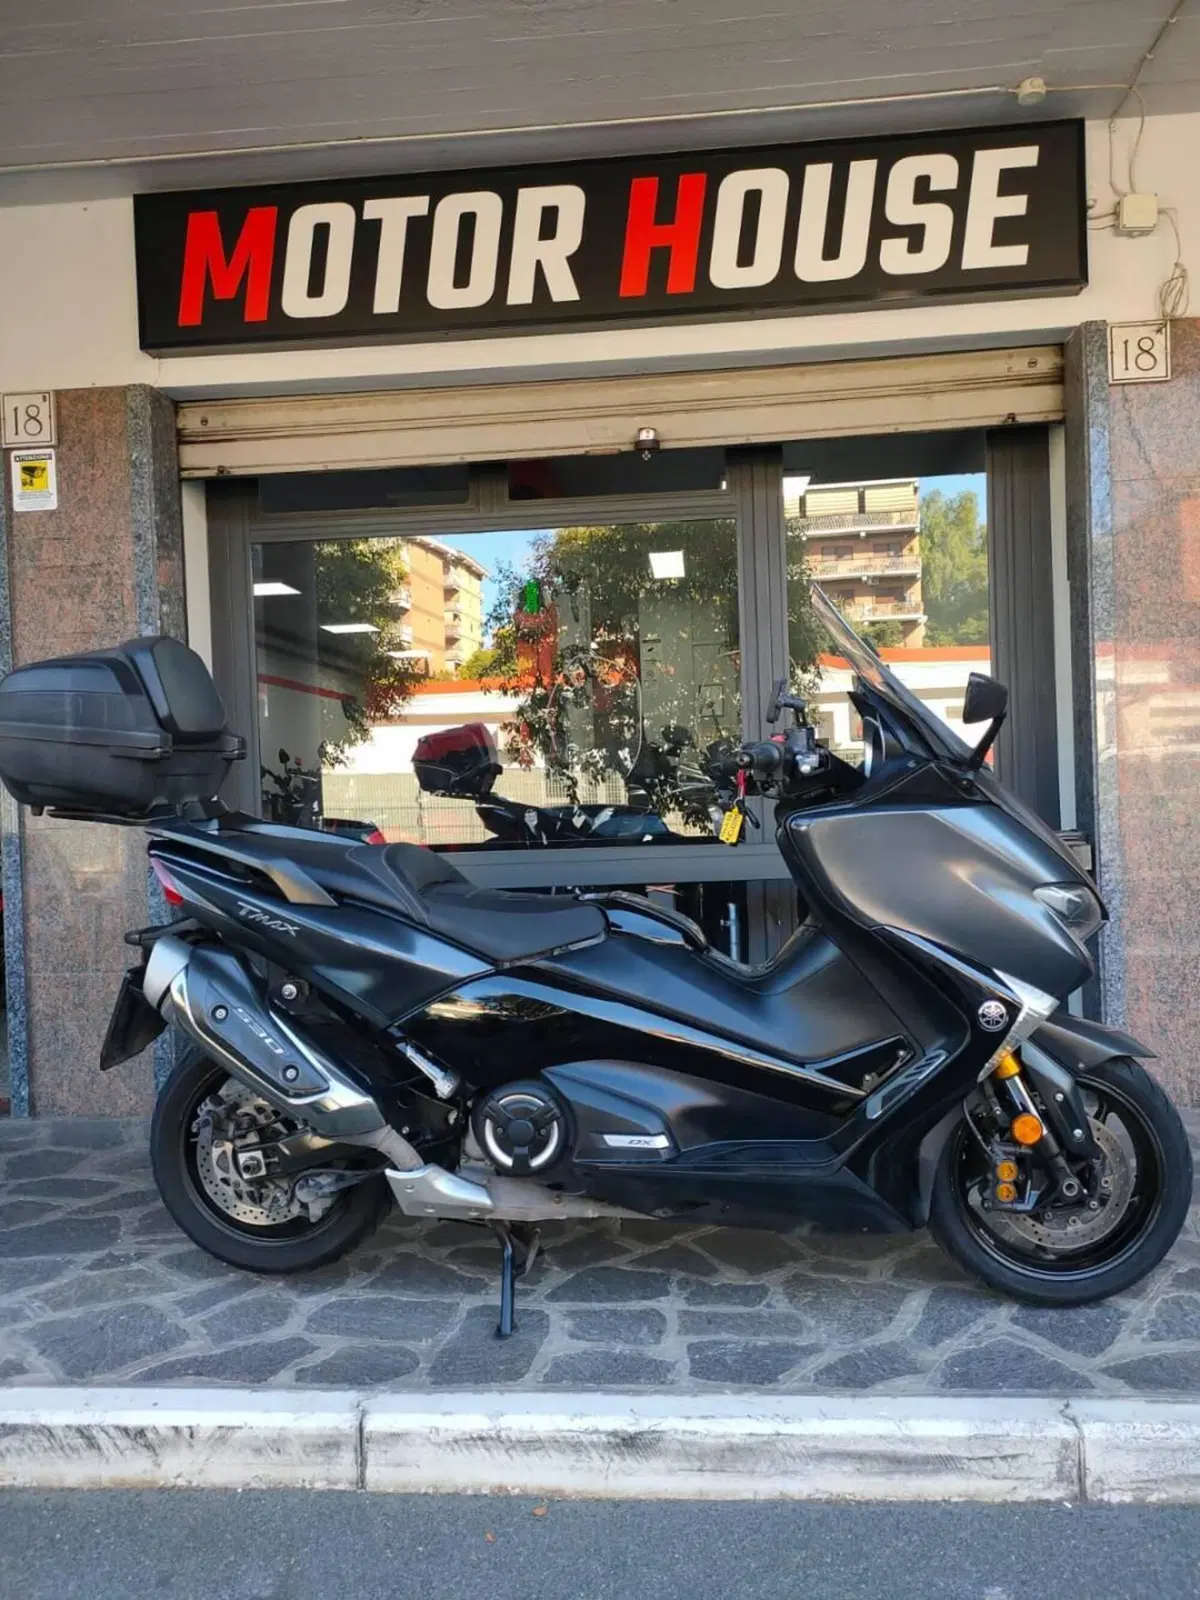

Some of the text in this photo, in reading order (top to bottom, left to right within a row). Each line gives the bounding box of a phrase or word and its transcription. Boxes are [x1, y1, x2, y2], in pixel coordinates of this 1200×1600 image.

[179, 146, 1039, 326] MOTOR HOUSE
[1123, 336, 1157, 371] 18
[13, 404, 43, 437] 18
